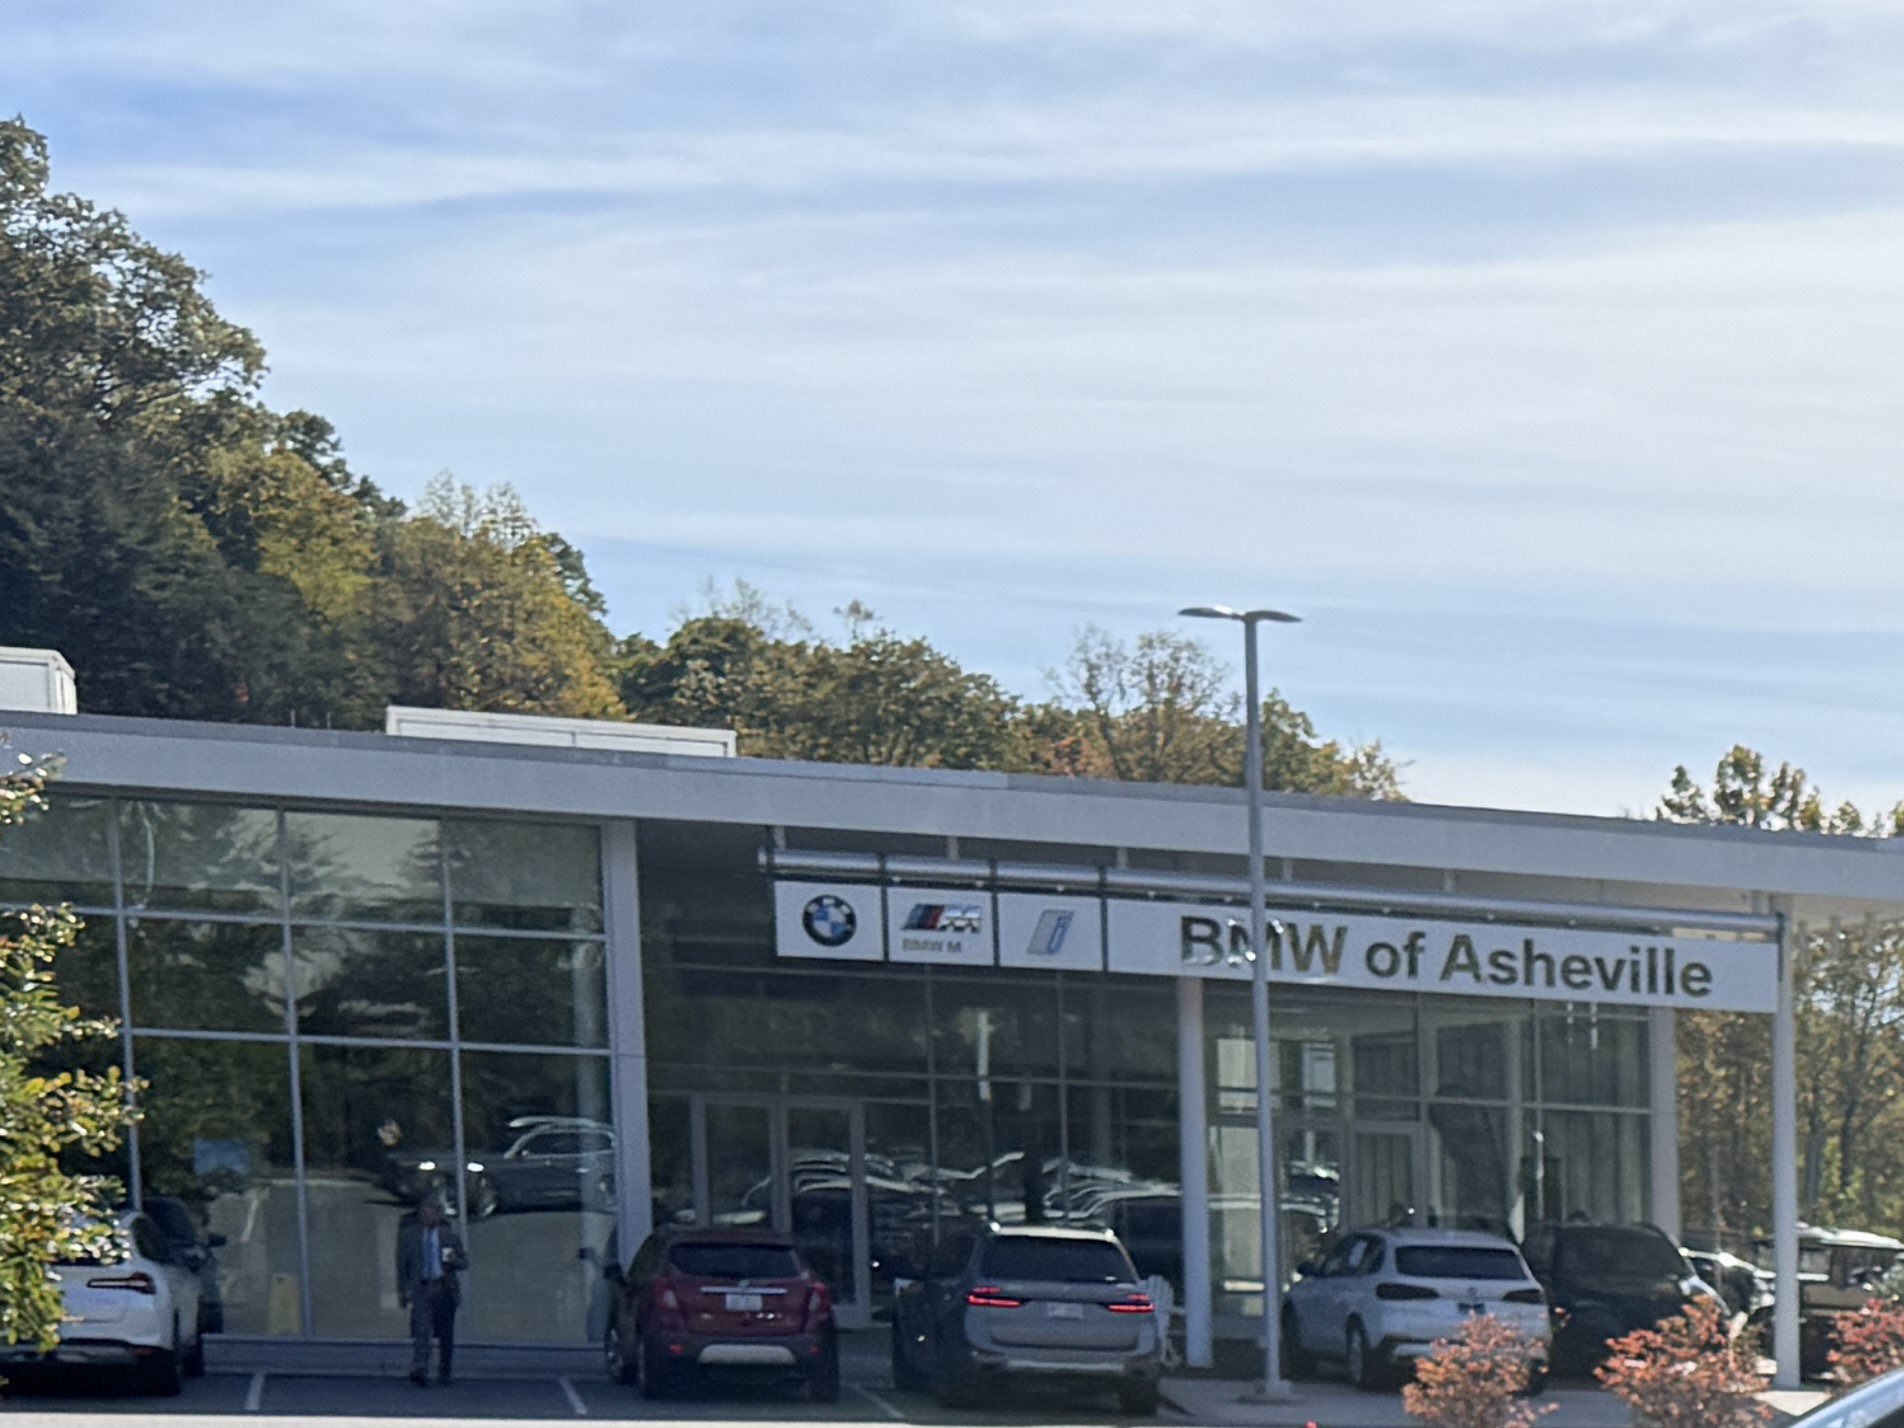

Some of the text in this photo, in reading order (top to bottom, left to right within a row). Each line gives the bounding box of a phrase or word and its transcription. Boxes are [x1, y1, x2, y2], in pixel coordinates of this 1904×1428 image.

[1180, 914, 1713, 997] BMW of Asheville
